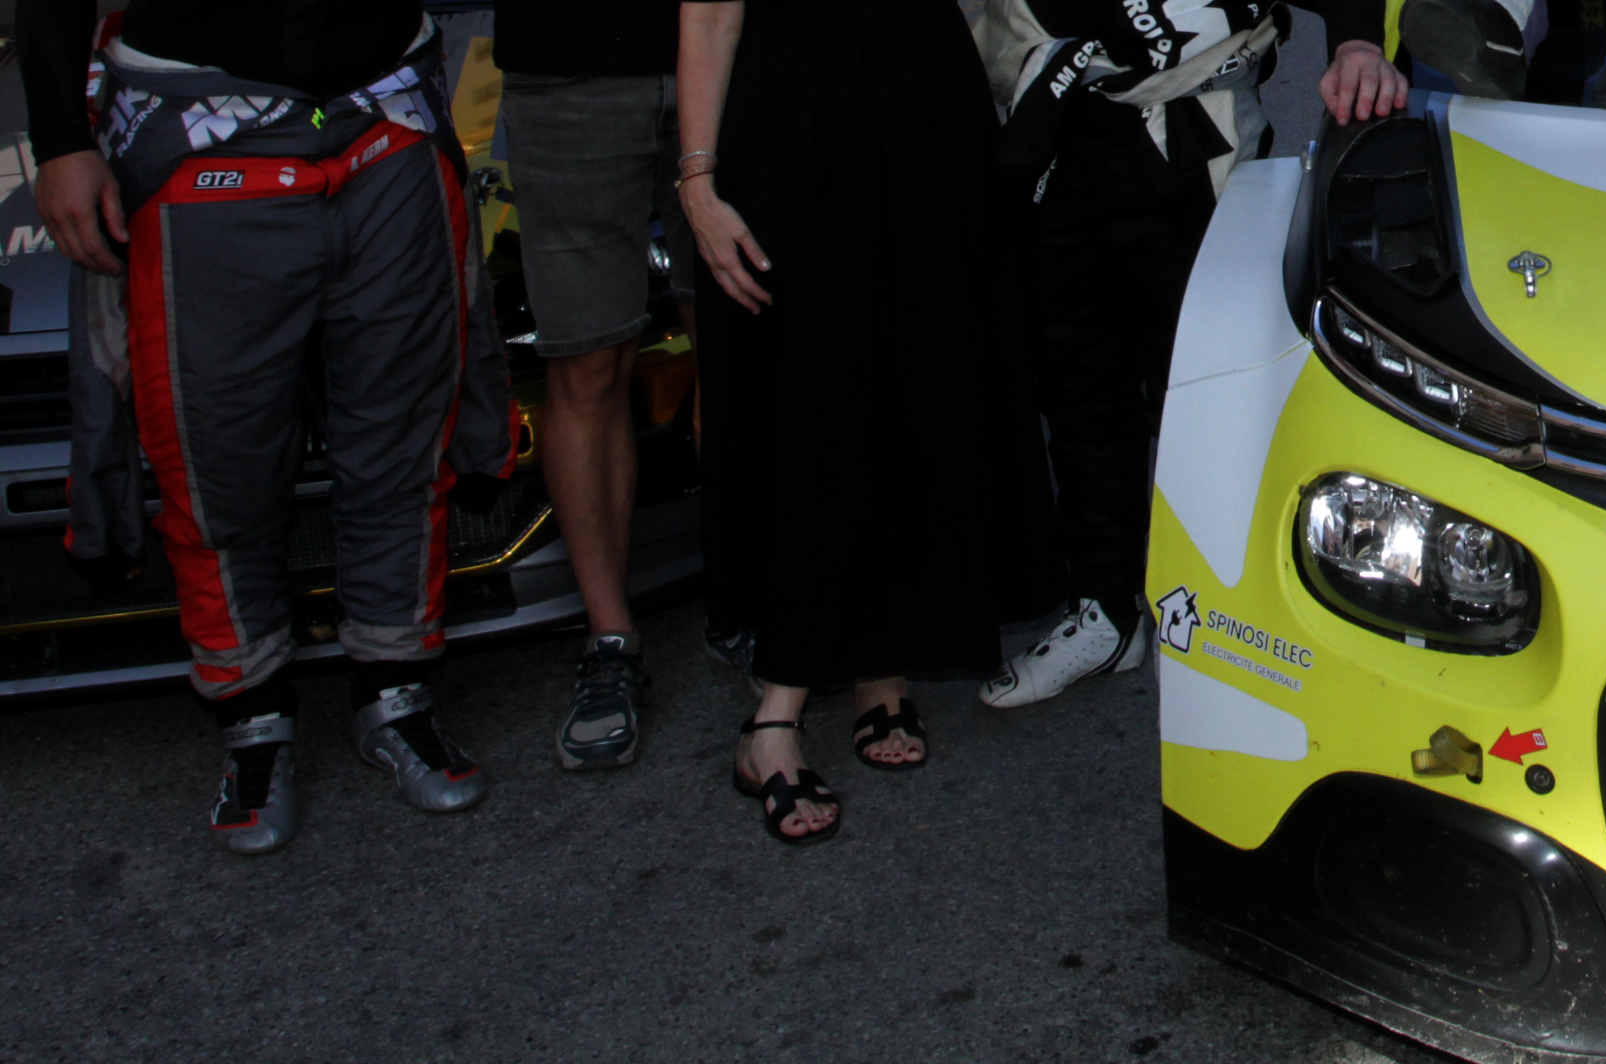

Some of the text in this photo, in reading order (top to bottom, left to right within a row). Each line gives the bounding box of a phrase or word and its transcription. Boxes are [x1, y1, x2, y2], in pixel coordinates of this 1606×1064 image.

[1049, 64, 1077, 99] AM
[1206, 610, 1314, 670] SPINOSI ELEC
[1202, 641, 1302, 693] ELECTRICITE GENERALE
